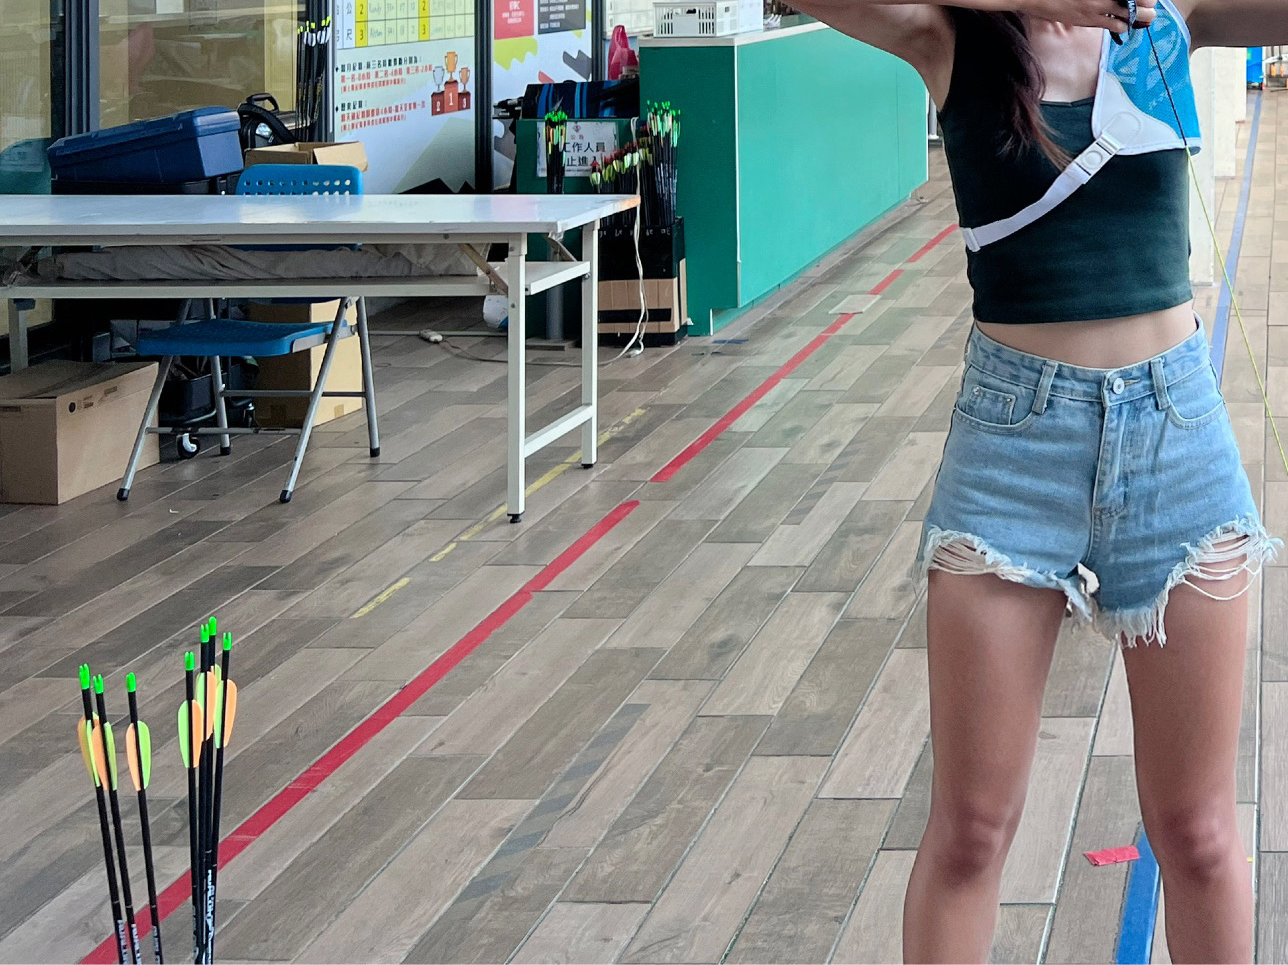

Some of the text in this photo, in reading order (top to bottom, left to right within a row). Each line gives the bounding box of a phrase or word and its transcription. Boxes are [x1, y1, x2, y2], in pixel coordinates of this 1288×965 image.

[449, 91, 453, 106] 1
[563, 142, 606, 153] 工作人員
